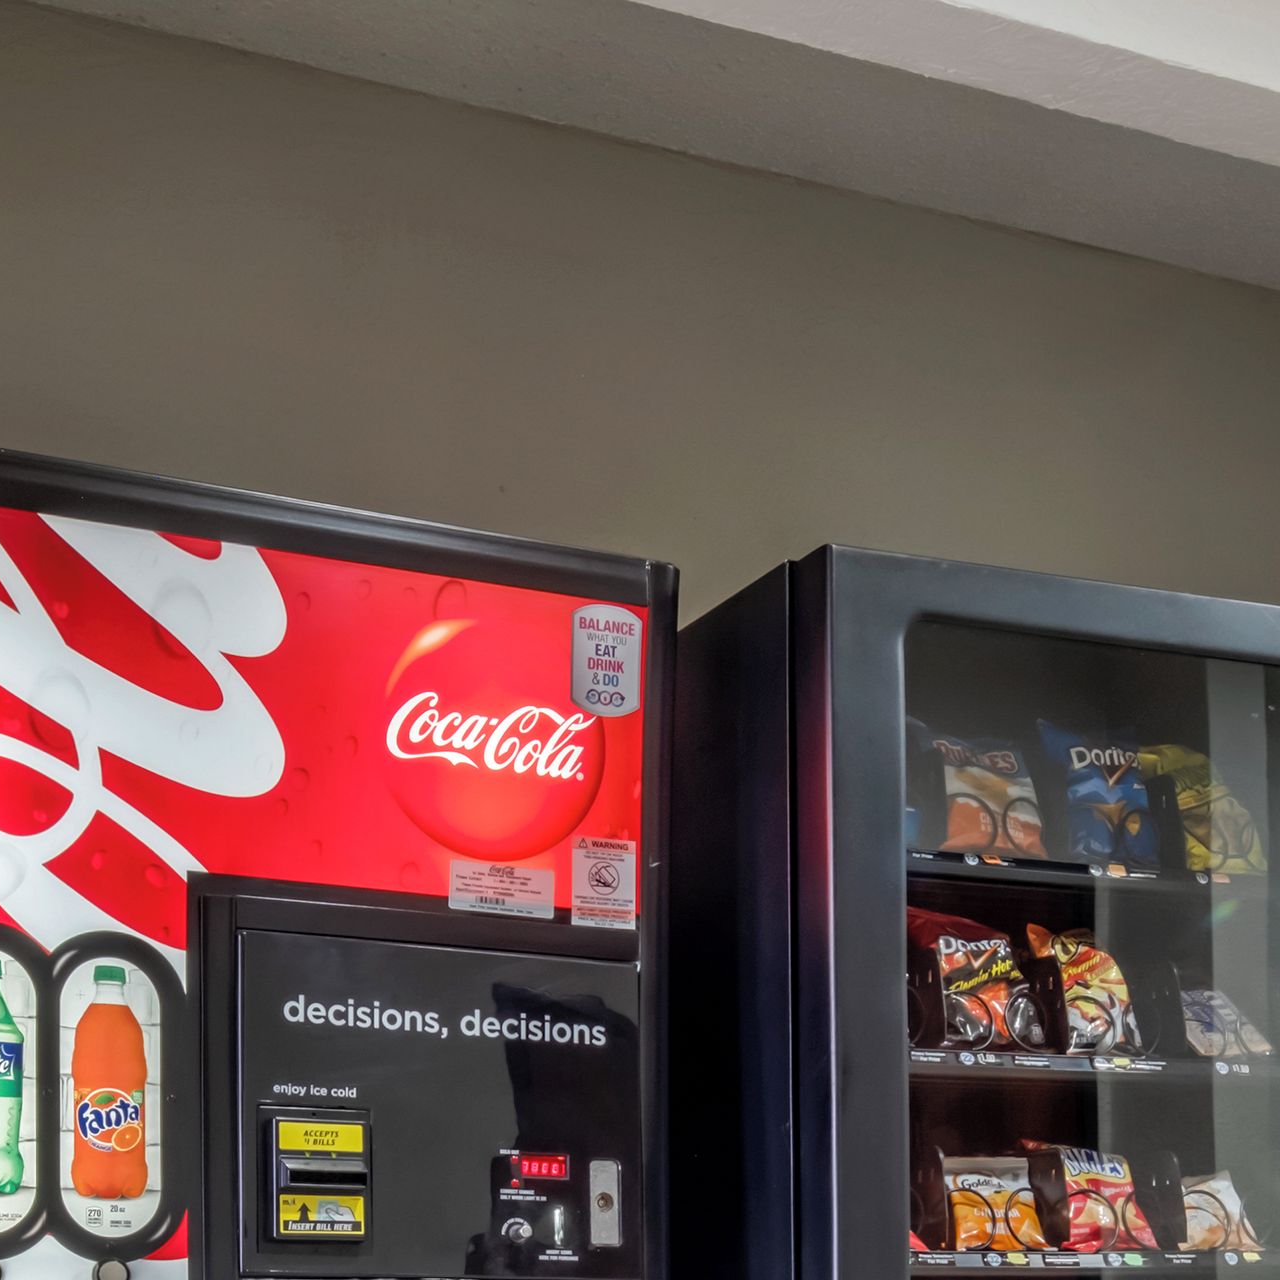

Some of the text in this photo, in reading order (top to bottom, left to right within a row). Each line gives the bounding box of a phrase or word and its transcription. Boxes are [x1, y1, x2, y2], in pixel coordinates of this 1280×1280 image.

[579, 616, 635, 636] BALANCE
[587, 632, 627, 646] WHAT YOU
[587, 657, 624, 674] DRINK
[592, 671, 619, 687] & DO
[386, 691, 596, 778] Coca-Cola
[591, 840, 629, 851] WARNING
[283, 994, 607, 1047] decisions, decisions
[273, 1083, 357, 1098] enjoy ice cold
[77, 1098, 139, 1141] Fanta
[303, 1129, 339, 1138] ACCEPTS
[313, 1138, 336, 1146] BILLS
[88, 1209, 102, 1217] 270
[110, 1205, 118, 1213] 20
[288, 1221, 353, 1231] INSERT BILL HERE
